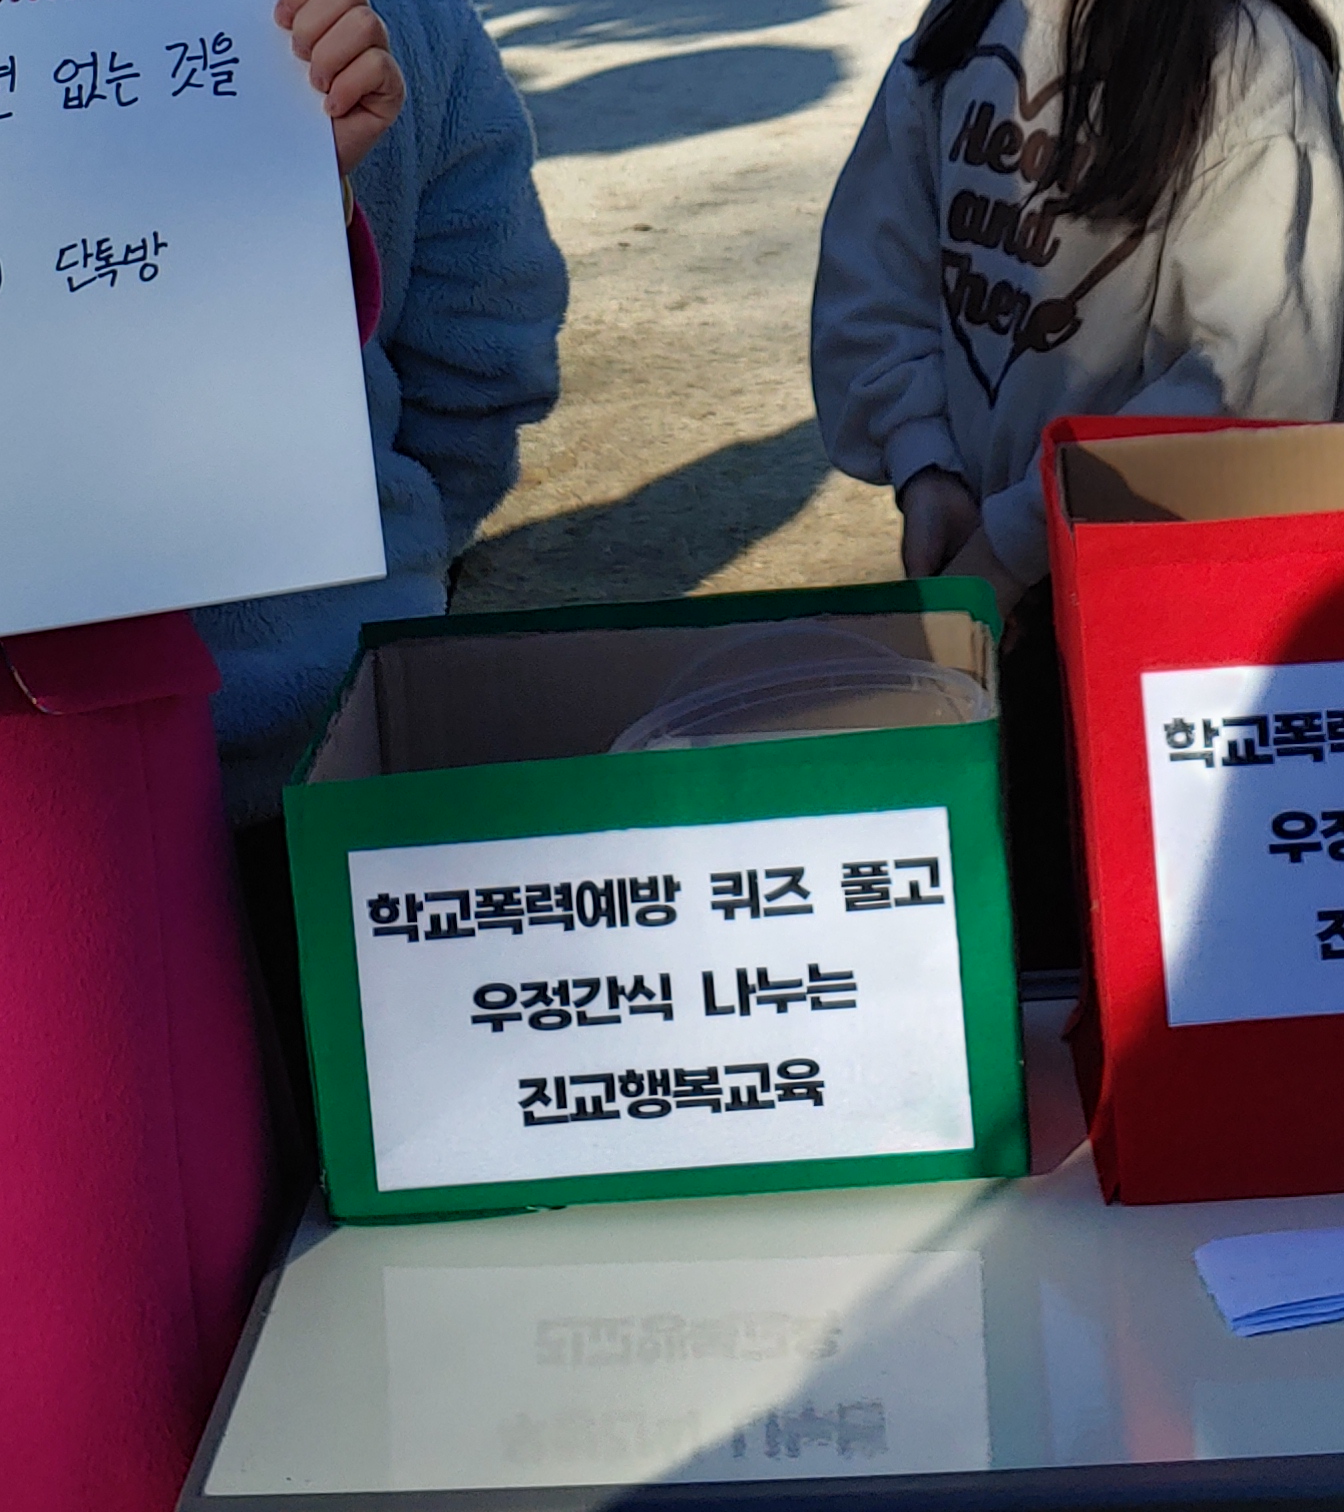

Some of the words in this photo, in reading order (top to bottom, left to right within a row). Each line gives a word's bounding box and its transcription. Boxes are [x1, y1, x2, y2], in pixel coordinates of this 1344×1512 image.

[53, 51, 140, 109] 없는
[165, 32, 239, 97] 것을
[56, 231, 168, 292] 단톡방
[367, 875, 681, 943] 학교폭력예방
[711, 867, 813, 920] 퀴즈
[841, 857, 944, 912] 풀고
[471, 973, 673, 1033] 우정간식
[702, 964, 857, 1016] 나누는
[518, 1059, 825, 1127] 진교행복교육
